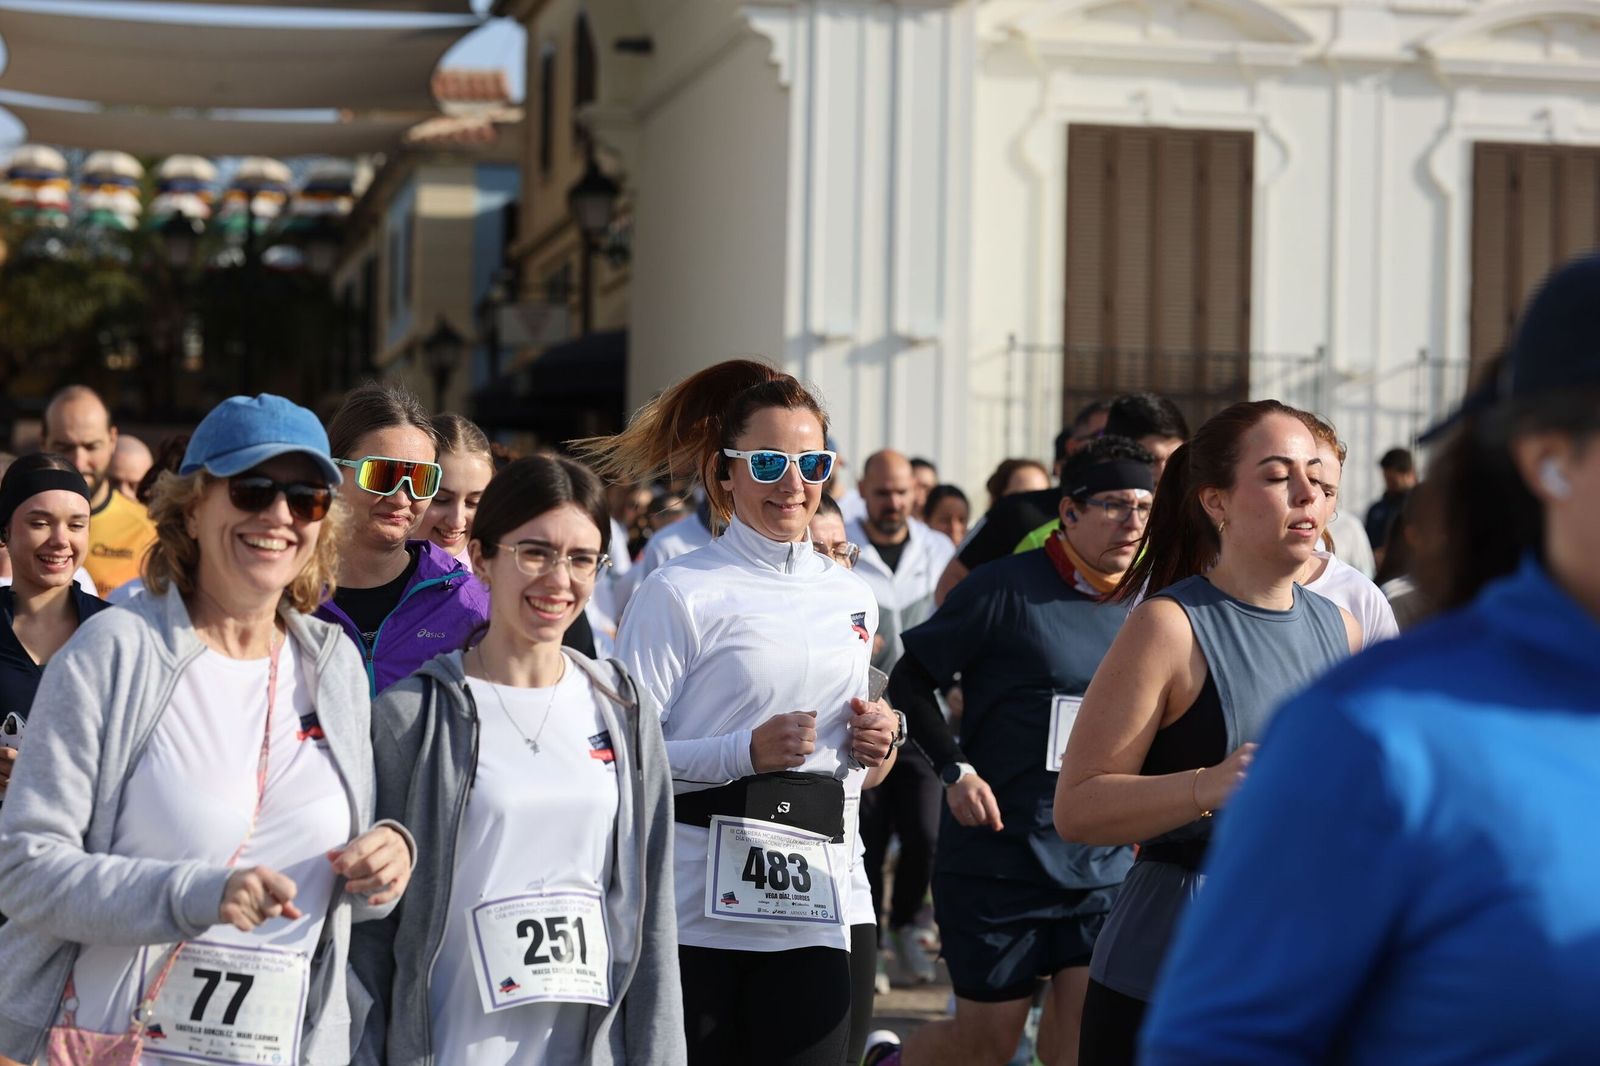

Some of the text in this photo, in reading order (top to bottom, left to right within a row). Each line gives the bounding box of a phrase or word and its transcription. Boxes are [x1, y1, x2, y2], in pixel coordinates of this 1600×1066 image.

[741, 846, 812, 893] 483
[791, 894, 811, 902] LOURDES
[516, 916, 587, 966] 251
[190, 968, 255, 1026] 77
